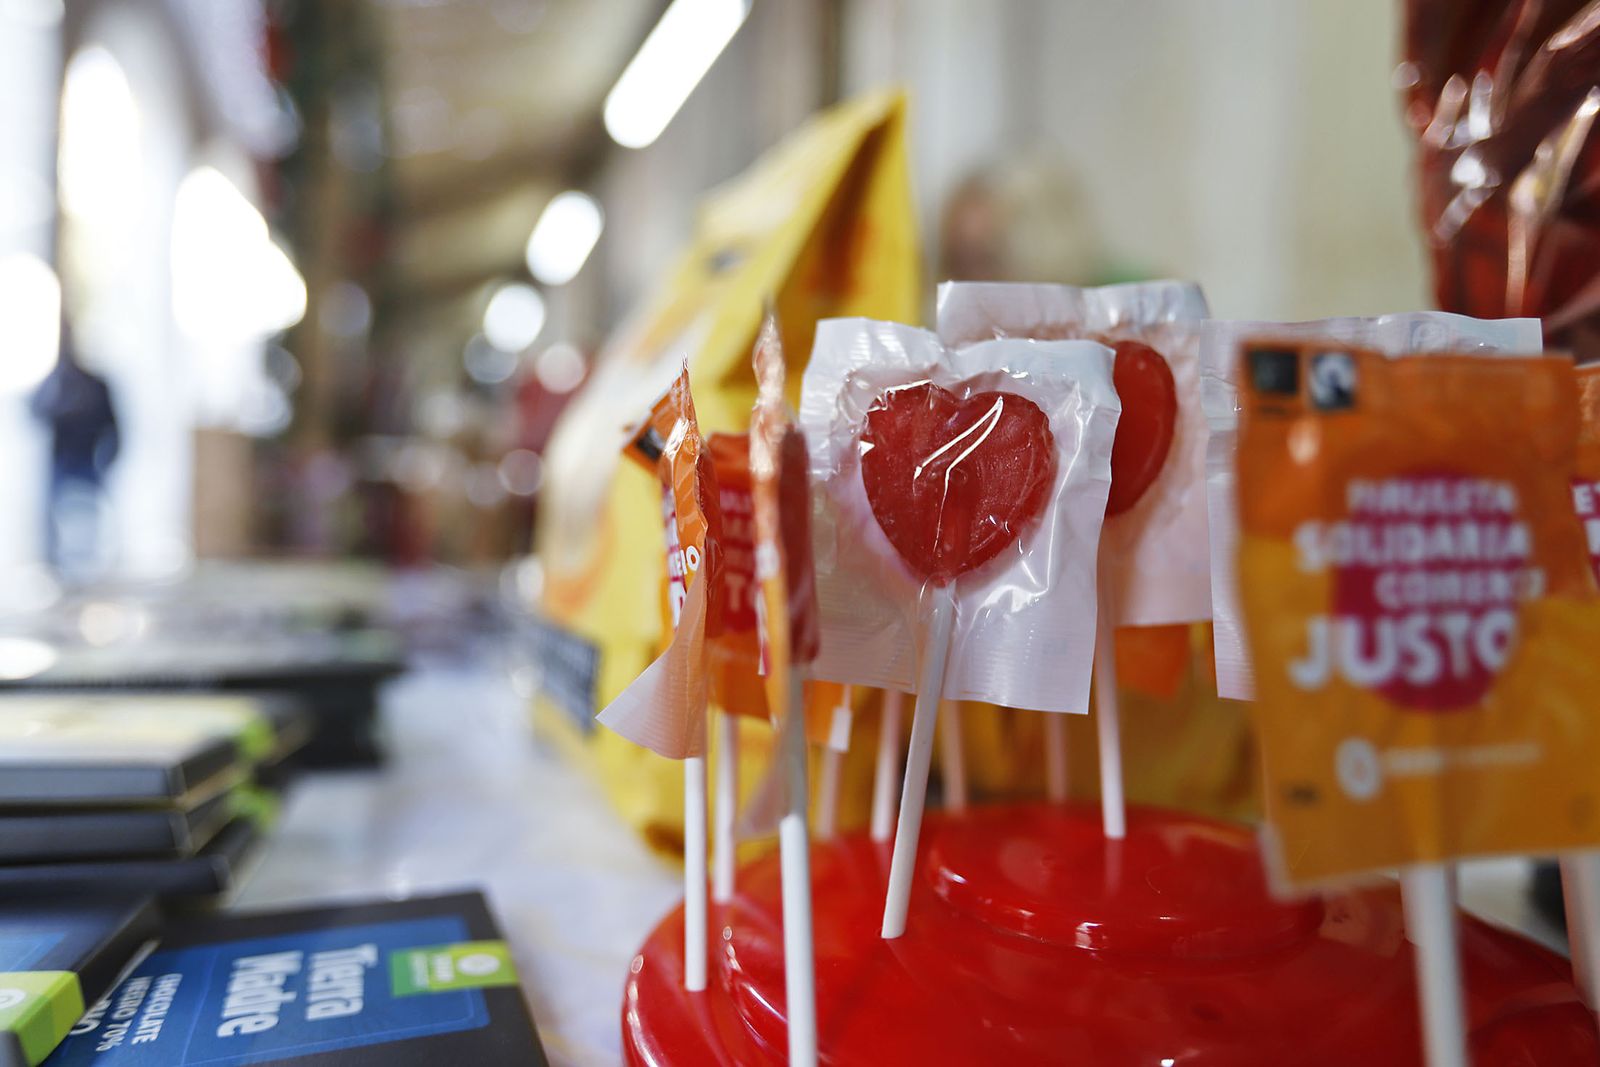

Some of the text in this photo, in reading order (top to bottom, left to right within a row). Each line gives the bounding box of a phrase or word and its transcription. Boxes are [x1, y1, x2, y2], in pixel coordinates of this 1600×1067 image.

[1294, 519, 1533, 572] SOLIDARIA
[1287, 610, 1517, 689] JUSTO
[131, 973, 183, 1045] CHOCOLATE
[216, 950, 304, 1038] Madre
[304, 943, 379, 1021] Tierra
[95, 1019, 133, 1051] 70%
